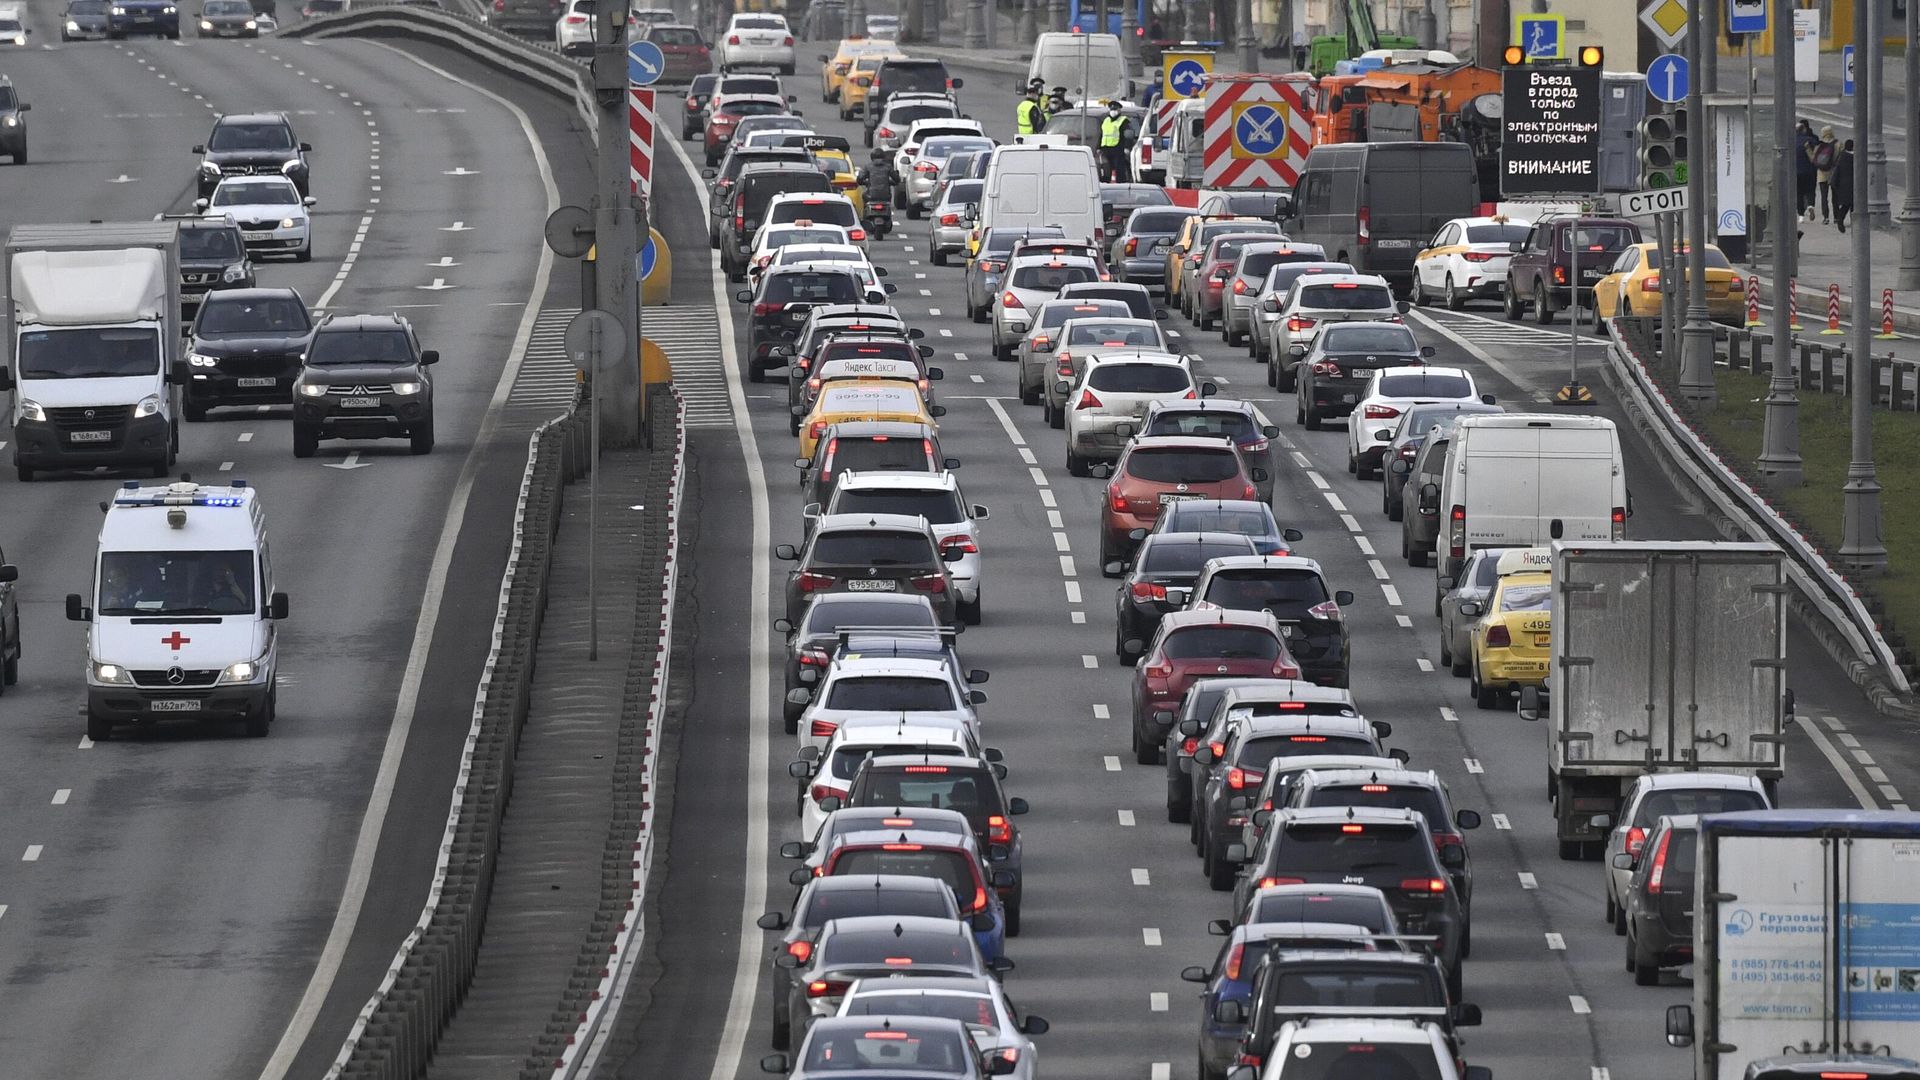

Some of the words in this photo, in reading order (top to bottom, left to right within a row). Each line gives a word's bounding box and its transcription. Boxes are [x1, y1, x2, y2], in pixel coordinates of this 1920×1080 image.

[1530, 72, 1572, 86] Въезд
[1528, 88, 1537, 97] в
[1538, 88, 1579, 99] город
[1529, 99, 1576, 109] только
[1543, 111, 1560, 120] по
[1507, 122, 1598, 133] электронным
[803, 137, 826, 147] Uber
[1517, 133, 1588, 144] пропускам
[1508, 160, 1593, 174] ВНИМАНИЕ
[1630, 190, 1683, 212] СТОП
[844, 361, 872, 373] Яндекс
[875, 361, 897, 373] Такси
[1342, 875, 1365, 885] Jeep
[1731, 959, 1738, 969] 8
